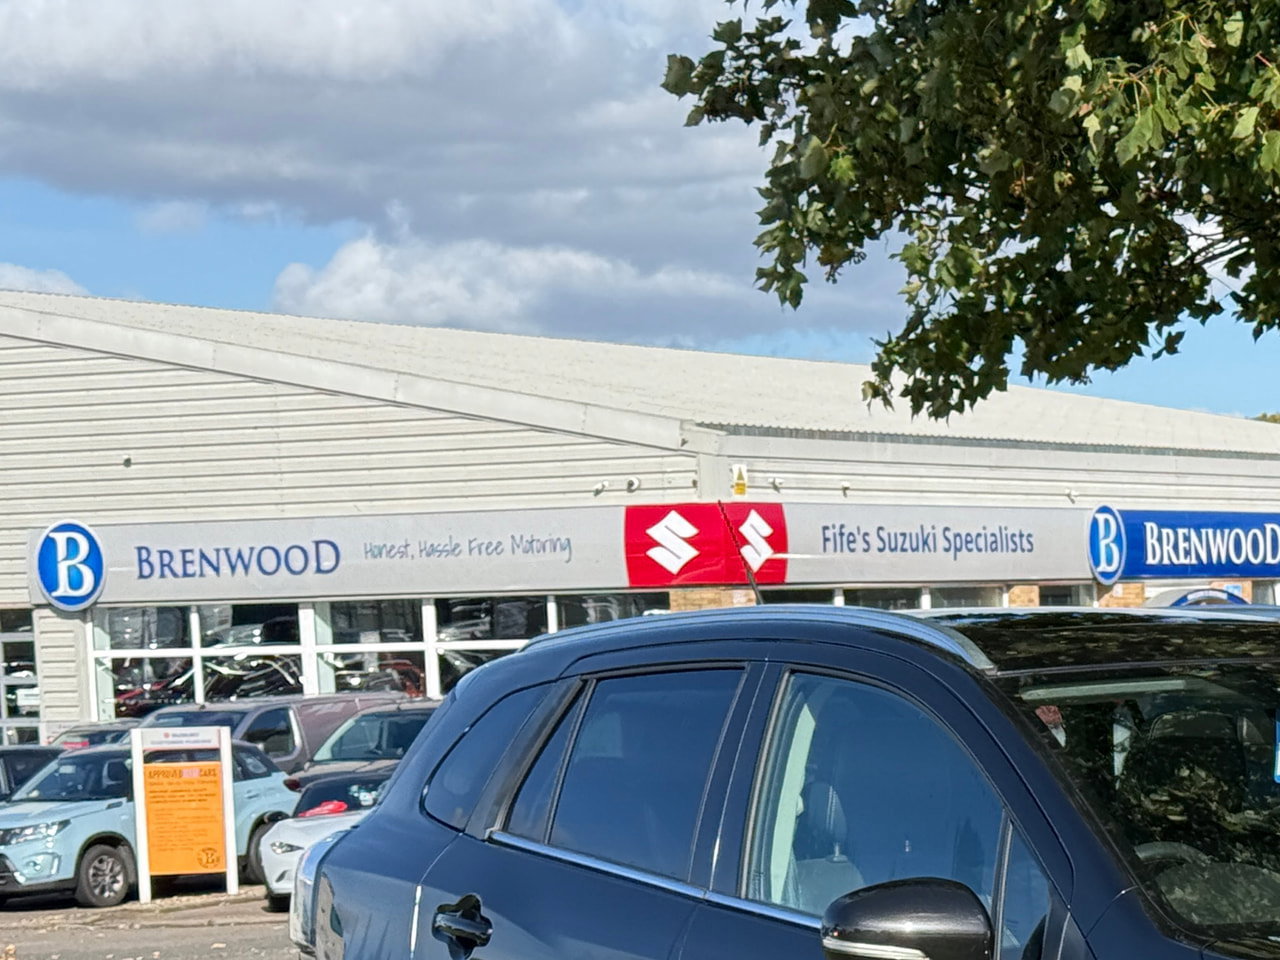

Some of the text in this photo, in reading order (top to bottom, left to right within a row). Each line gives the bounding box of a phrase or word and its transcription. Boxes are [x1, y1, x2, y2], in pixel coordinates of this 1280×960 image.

[133, 539, 341, 580] BRENWOOD
[364, 533, 573, 564] Honest, Hassle Free Motoring
[821, 523, 1035, 561] Fife's Suzuki Specialists
[1095, 513, 1120, 573] B
[48, 531, 95, 597] B
